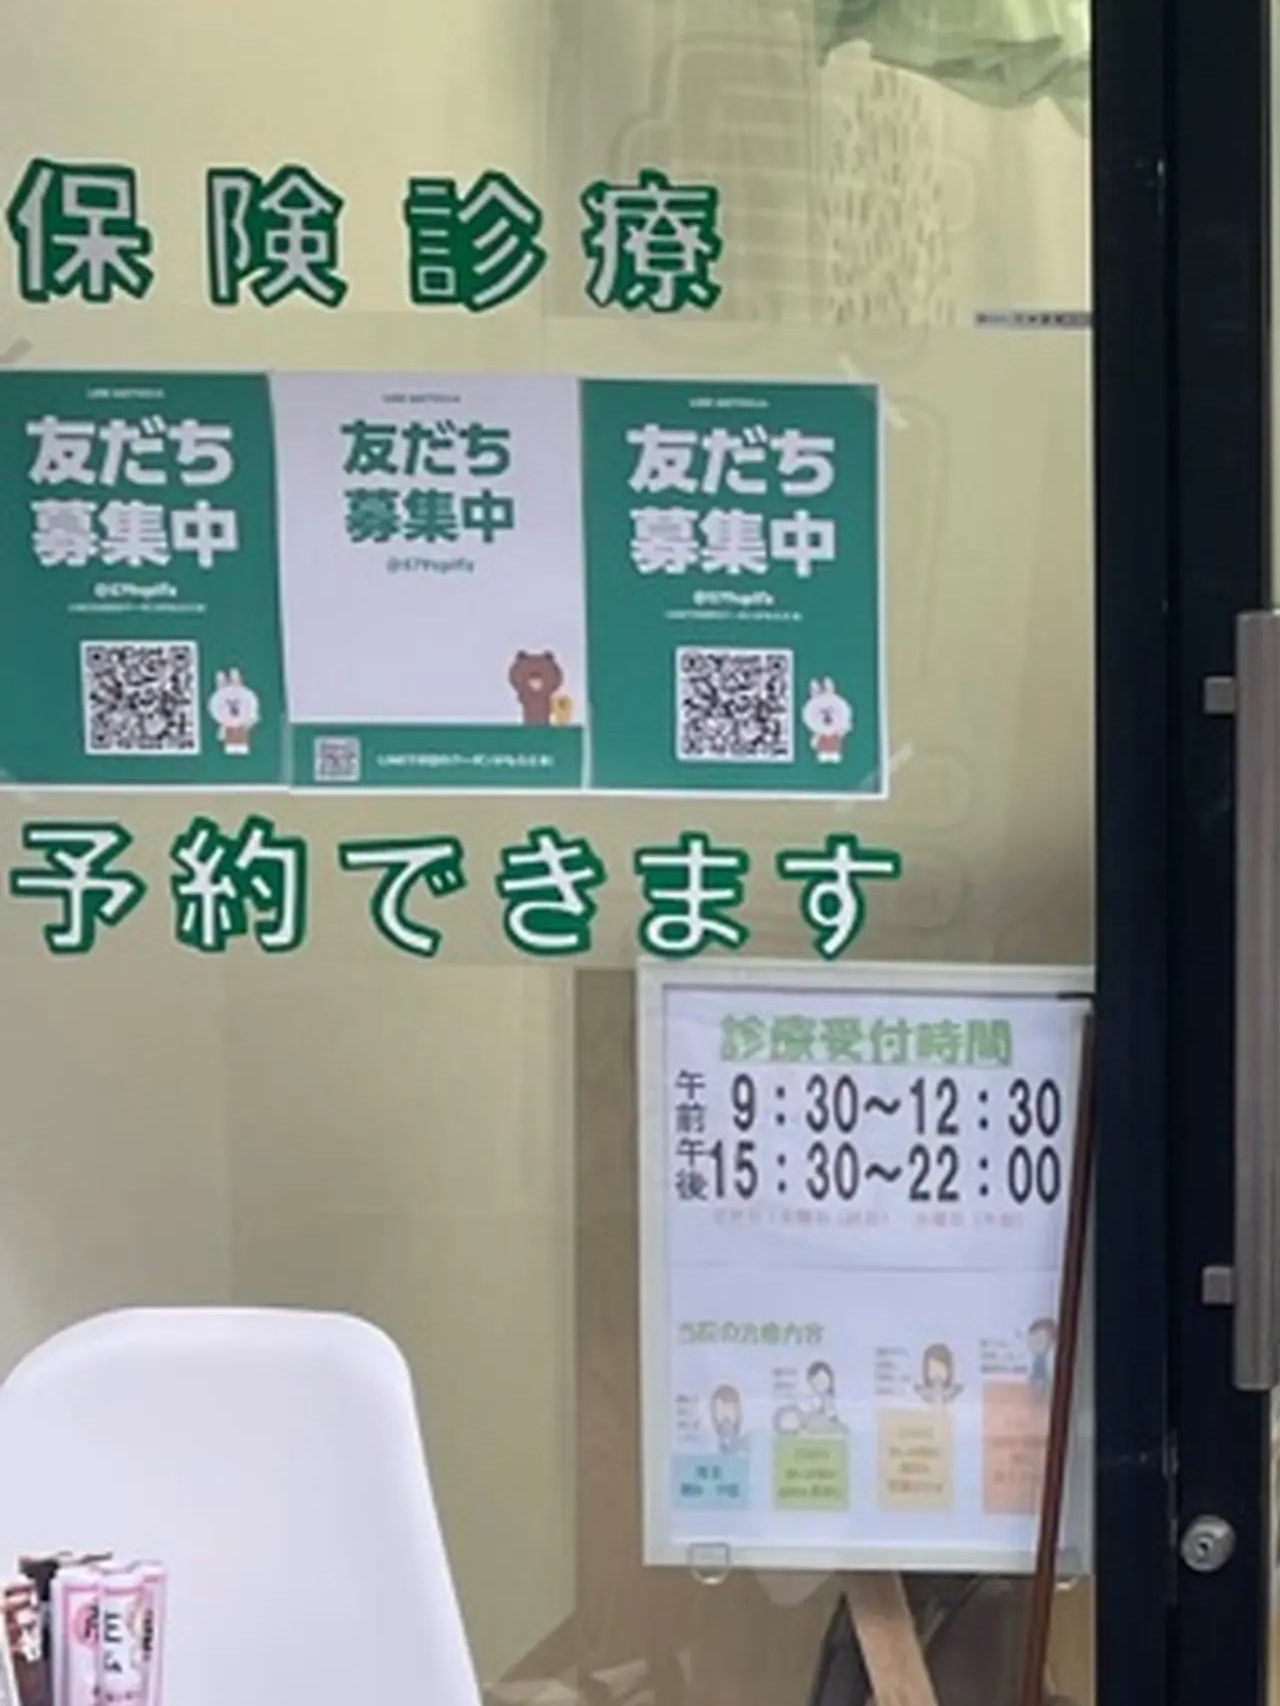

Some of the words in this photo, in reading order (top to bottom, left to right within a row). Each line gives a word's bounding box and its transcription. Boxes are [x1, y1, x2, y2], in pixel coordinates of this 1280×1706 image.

[6, 158, 721, 311] 保険診療
[25, 414, 233, 486] 友だち
[339, 418, 512, 477] 友だち
[626, 423, 836, 497] 友だち
[29, 497, 239, 569] 募集中
[342, 486, 515, 544] 募集中
[629, 506, 837, 579] 募集中
[10, 814, 904, 961] 予約できます
[719, 1013, 1014, 1067] 診療受付時間
[675, 1069, 706, 1134] 午前
